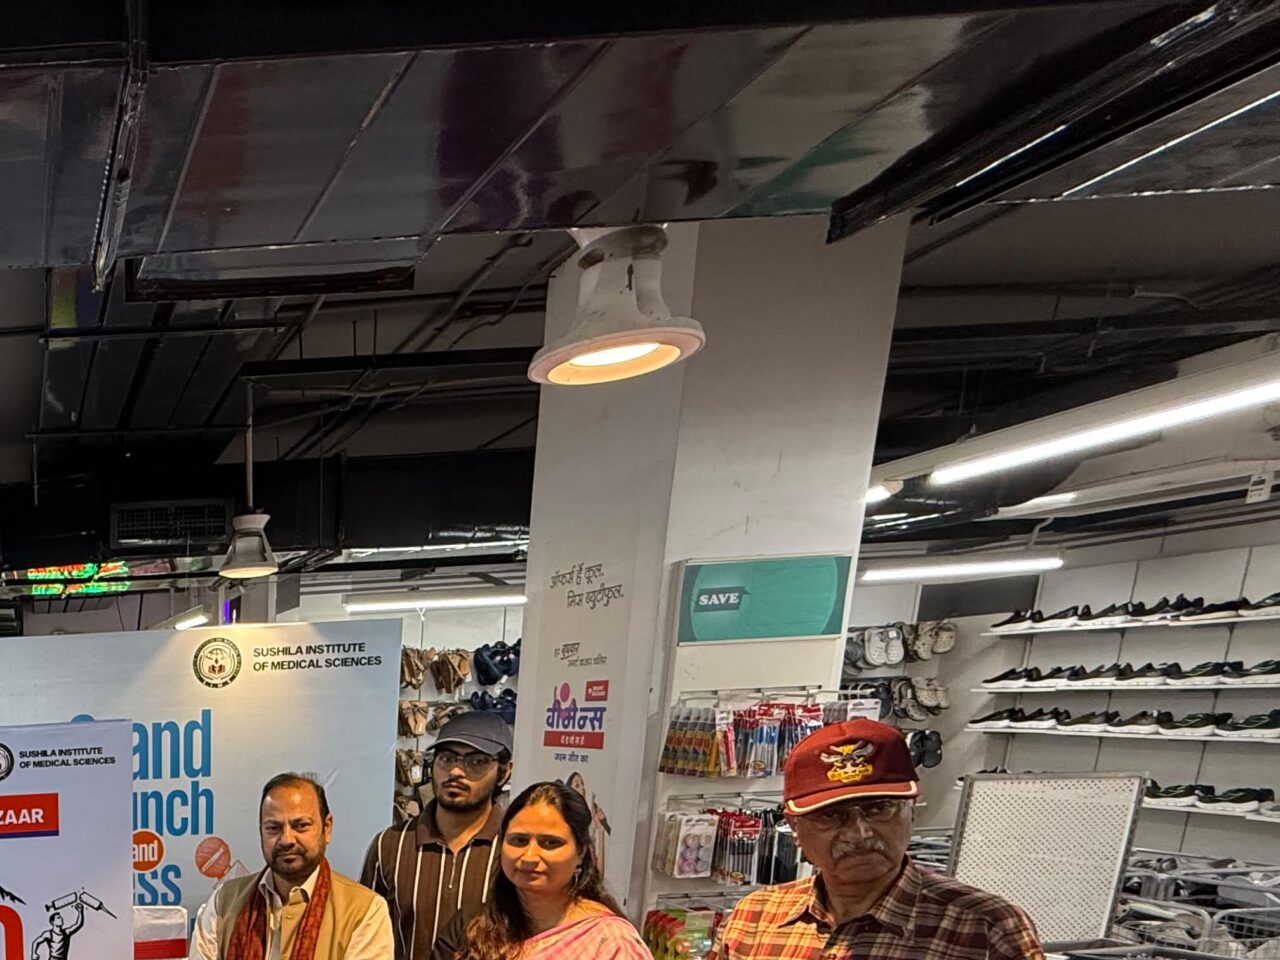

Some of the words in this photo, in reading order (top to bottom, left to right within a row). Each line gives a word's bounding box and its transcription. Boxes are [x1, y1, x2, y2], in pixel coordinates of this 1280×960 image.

[699, 592, 739, 605] SAVE
[253, 645, 304, 658] SUSHILA
[305, 642, 366, 654] INSTITUTE
[253, 661, 269, 671] OF
[270, 659, 323, 670] MEDICAL
[324, 656, 382, 668] SCIENCES
[19, 749, 56, 759] SUSHILA
[58, 747, 103, 756] INSTITUTE
[20, 760, 31, 769] OF
[32, 758, 72, 768] MEDICAL
[73, 757, 116, 767] SCIENCES
